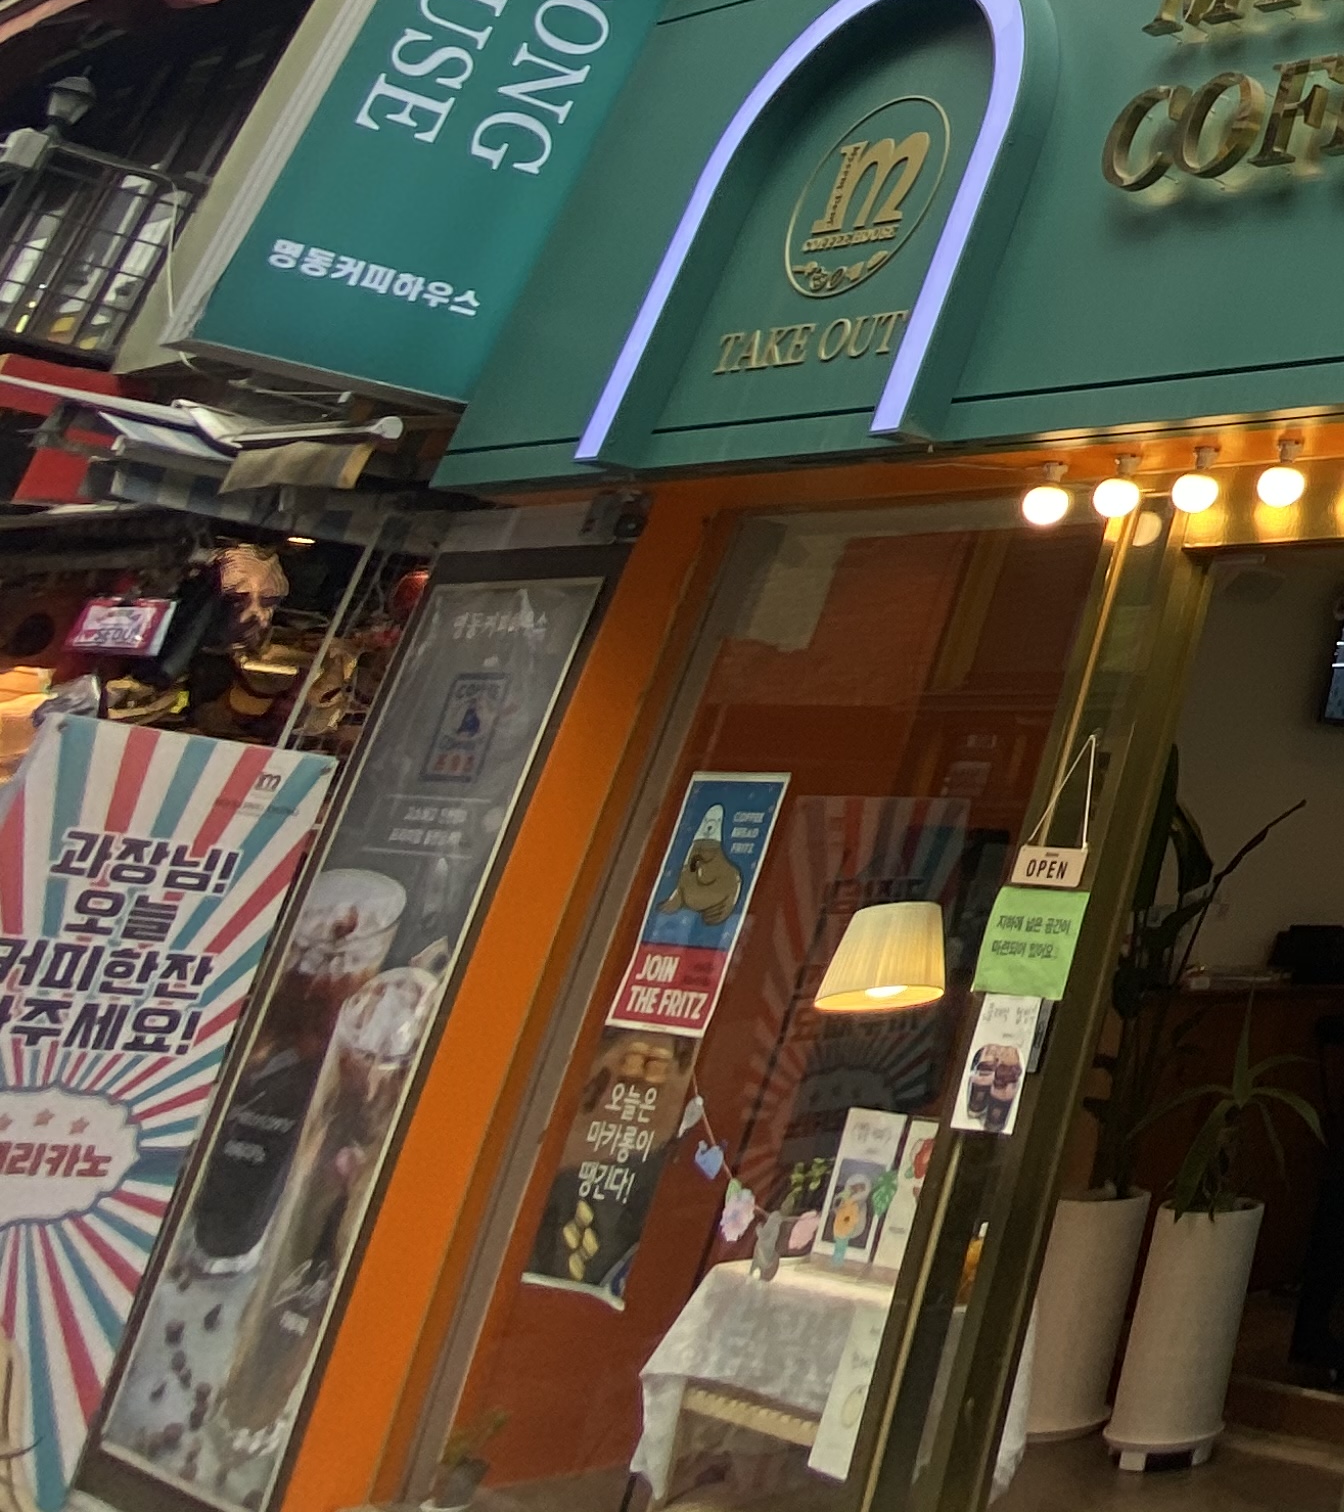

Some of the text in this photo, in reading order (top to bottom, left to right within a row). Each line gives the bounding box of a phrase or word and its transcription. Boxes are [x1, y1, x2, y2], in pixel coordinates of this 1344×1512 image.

[268, 238, 481, 317] 명동커피하우스
[713, 309, 910, 375] TAKE OUT
[50, 830, 240, 893] 과장님!
[1026, 859, 1069, 880] OPEN
[64, 889, 182, 943] 오늘
[635, 953, 681, 984] JOIN
[626, 985, 710, 1020] THE FRITZ
[603, 1082, 658, 1127] 오늘은
[0, 1142, 112, 1180] 리카노
[587, 1120, 655, 1164] 마카롱이
